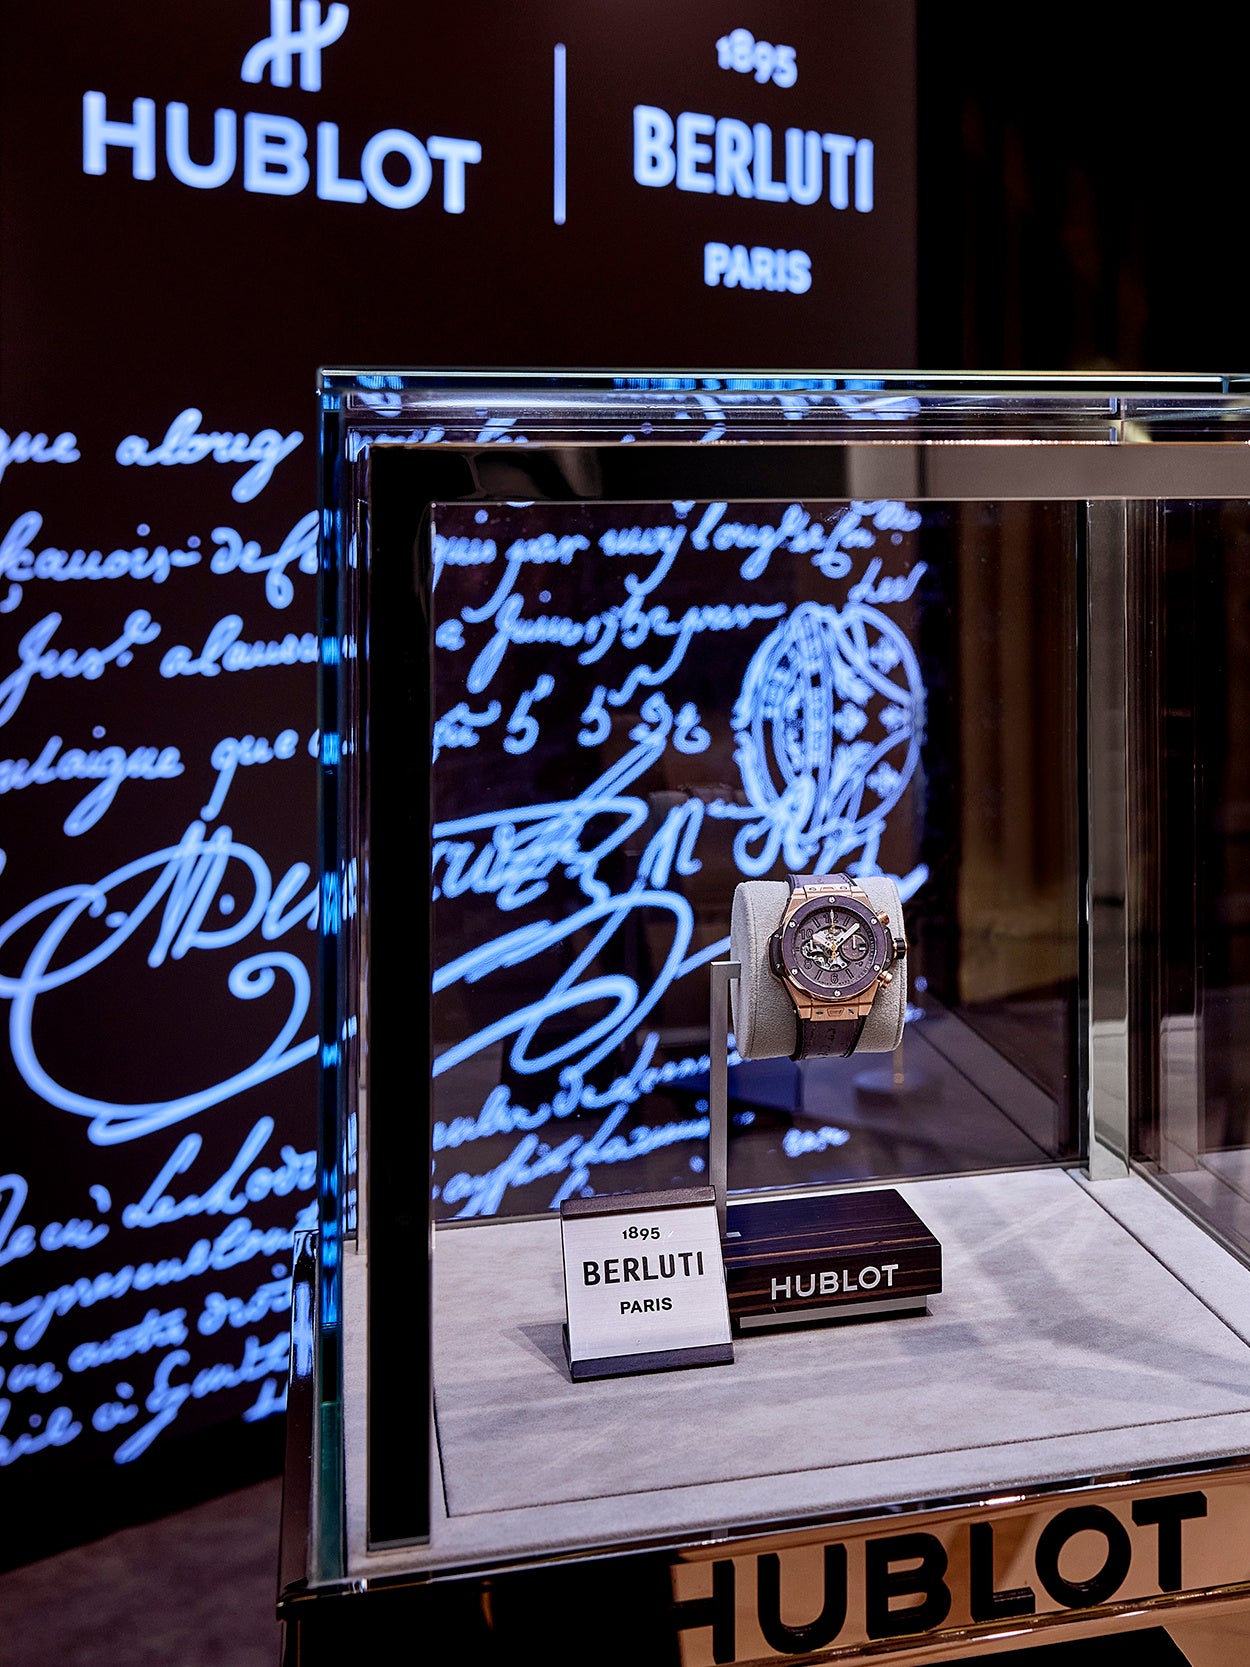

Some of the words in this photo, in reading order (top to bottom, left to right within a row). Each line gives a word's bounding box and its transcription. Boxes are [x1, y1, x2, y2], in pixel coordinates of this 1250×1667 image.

[716, 28, 797, 88] 1895
[82, 90, 482, 214] HUBLOT
[633, 105, 873, 212] BERLUTI
[704, 242, 812, 294] PARIS
[622, 1226, 661, 1241] 1895
[582, 1251, 704, 1286] BERLUTI
[771, 1264, 899, 1300] HUBLOT
[620, 1297, 673, 1315] PARIS
[668, 1491, 1208, 1665] HUBLOT
